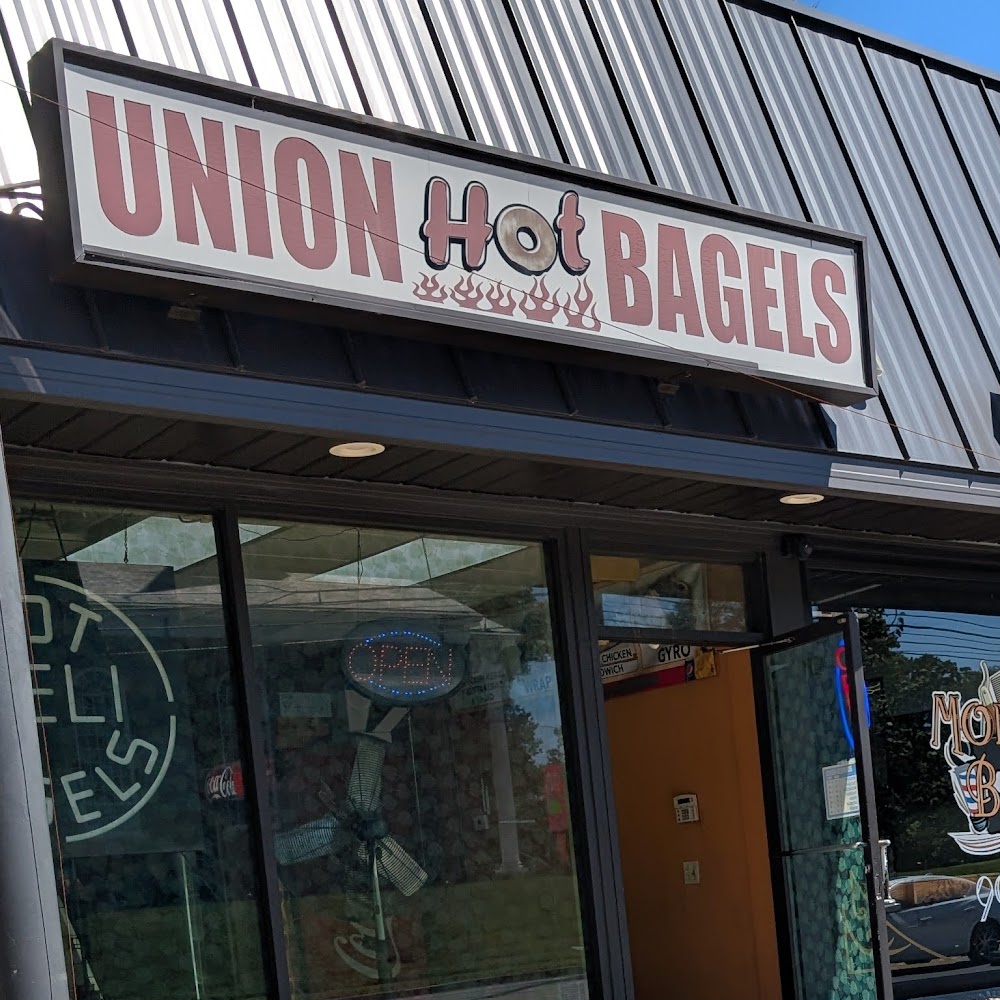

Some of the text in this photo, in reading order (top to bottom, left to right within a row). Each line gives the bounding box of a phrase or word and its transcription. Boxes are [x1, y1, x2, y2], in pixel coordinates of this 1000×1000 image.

[86, 91, 852, 364] UNION Hot BAGELS
[22, 595, 103, 653] OT
[347, 643, 452, 685] OPEN
[600, 664, 624, 677] DWICH
[602, 648, 632, 663] CHICKEN
[658, 645, 690, 662] GYRO
[30, 664, 123, 722] ELI
[43, 730, 158, 825] ELS
